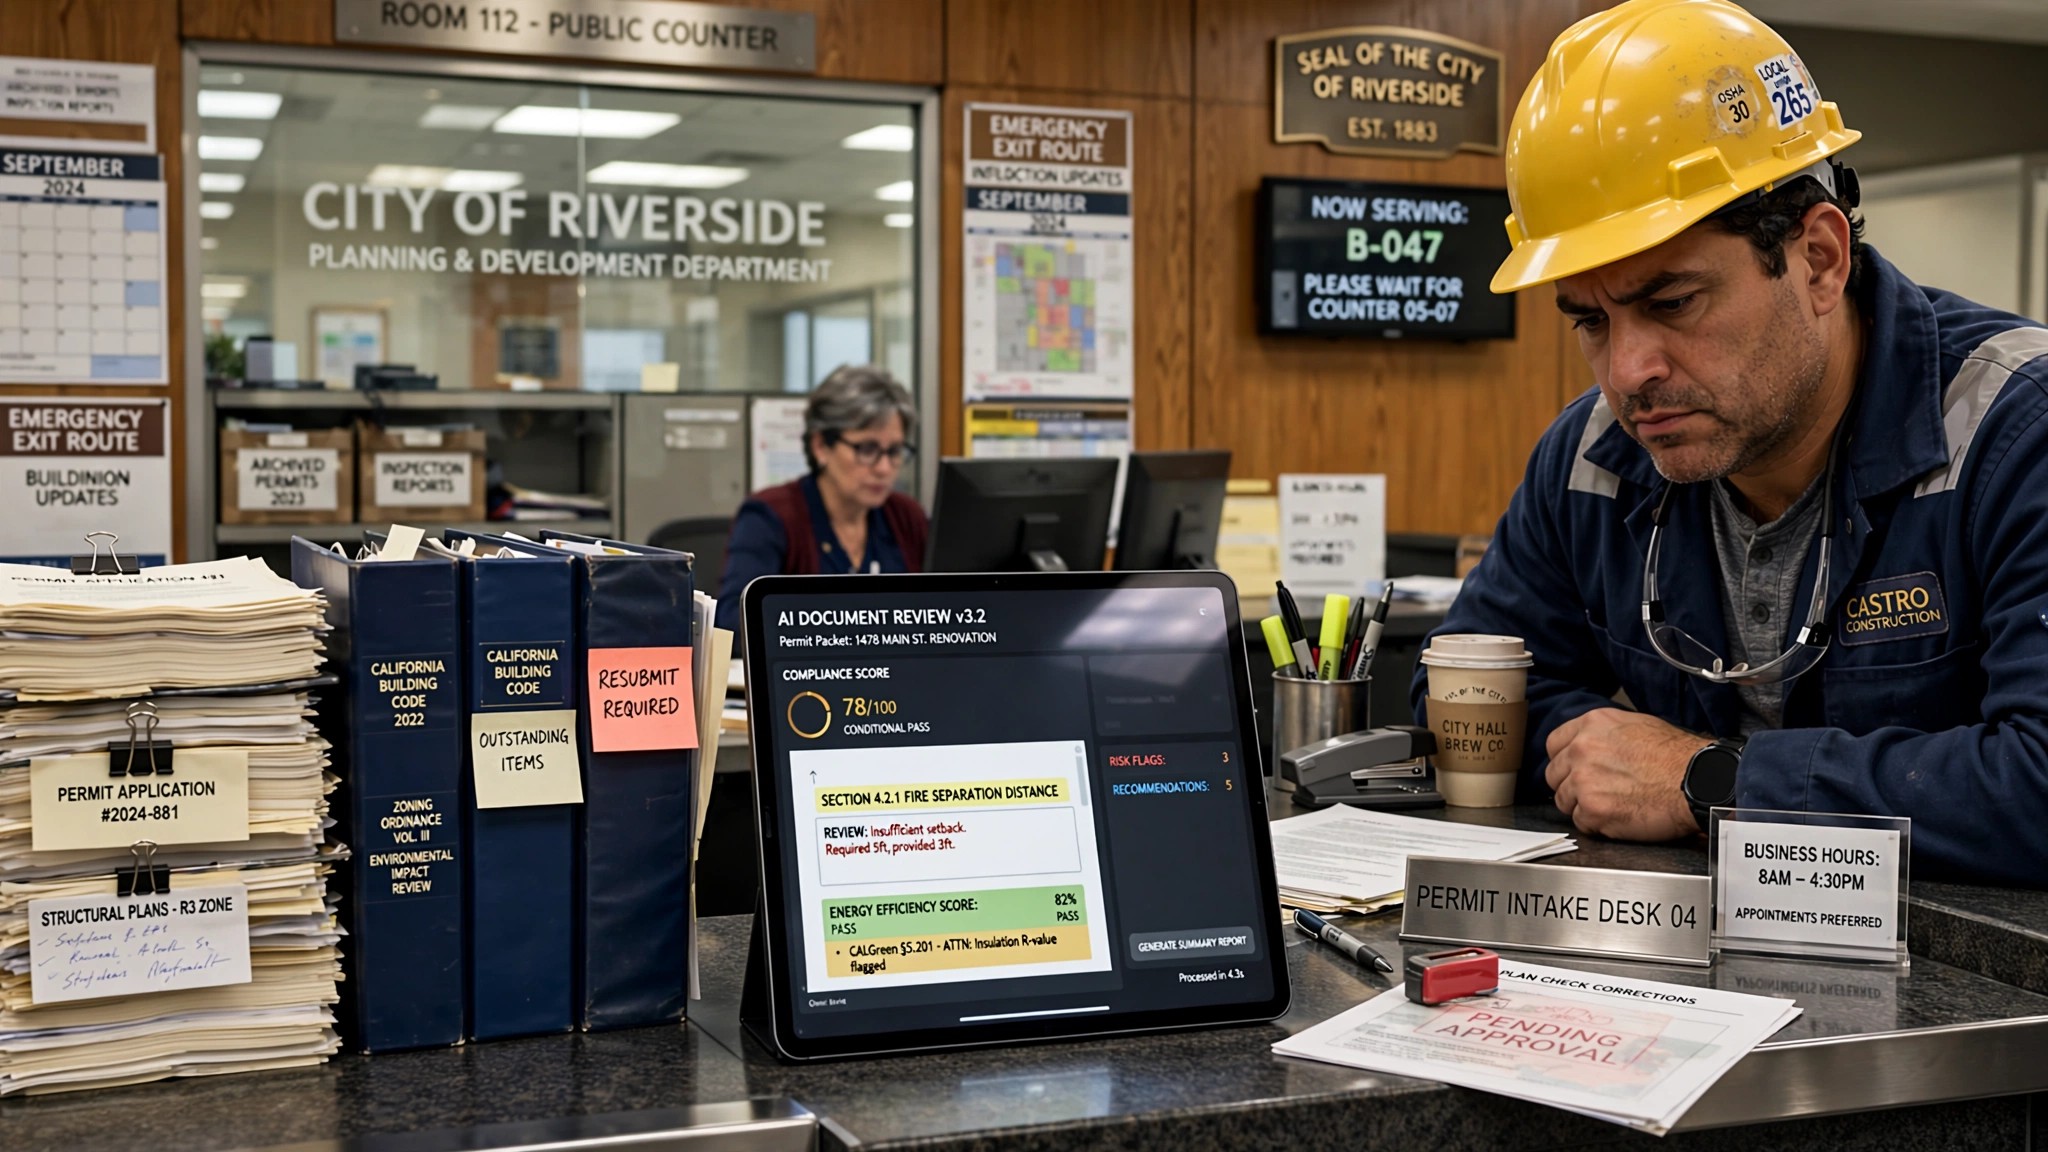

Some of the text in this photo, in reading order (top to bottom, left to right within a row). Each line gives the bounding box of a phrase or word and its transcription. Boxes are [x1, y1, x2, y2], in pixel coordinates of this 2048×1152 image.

[381, 0, 779, 52] ROOM 112 PUBLIC COUNTER
[1296, 41, 1486, 85] SEAL OF THE CITY
[1758, 59, 1789, 81] LOCAL
[1313, 74, 1464, 107] OF RIVERSIDE
[1717, 84, 1746, 104] OSHA
[1728, 100, 1750, 123] 30
[1771, 82, 1812, 126] 265
[990, 114, 1108, 140] EMERGENCY
[1347, 116, 1438, 143] EST. 1883
[992, 136, 1104, 163] EXIT ROUTE
[2, 153, 125, 177] SEPTEMBER
[43, 180, 85, 196] 2024
[978, 189, 1088, 213] SEPTEMBER
[1311, 195, 1469, 225] NOW SERVING:
[302, 182, 826, 247] CITY OF RIVERSIDE
[1346, 227, 1444, 264] B-047
[308, 242, 833, 283] PLANNING & DEVELOPMENT DEPARTMENT
[1303, 272, 1464, 299] PLEASE WAIT FOR
[1307, 297, 1460, 323] COUNTER 05-07
[8, 408, 143, 429] EMERGENCY
[12, 431, 140, 452] EXIT ROUTE
[250, 457, 326, 473] ARCHIVED
[381, 461, 465, 476] INSPECTION
[254, 474, 319, 489] PERMITS
[392, 477, 455, 494] REPORTS
[35, 489, 119, 507] UPDATES
[1846, 587, 1930, 619] CASTRO
[778, 608, 987, 627] AI DOCUMENT REVIEW v3.2
[1846, 608, 1942, 633] CONSTRUCTION
[779, 631, 998, 648] Permit Packet: 1478 MAIN ST. RENOVATION
[486, 648, 559, 664] CALIFORNIA
[370, 659, 446, 676] CALIFORNIA
[494, 664, 551, 680] BUILDING
[782, 666, 891, 681] COMPLIANCE SCORE
[379, 676, 438, 693] BUILDING
[505, 681, 541, 696] CODE
[598, 667, 680, 690] RESUBMIT
[391, 694, 427, 709] CODE
[603, 696, 680, 720] REQUIRED
[842, 696, 898, 717] 78/100
[393, 712, 425, 727] 2022
[843, 721, 931, 736] CONDITIONAL PASS
[1442, 719, 1508, 737] CITY HALL
[479, 727, 570, 749] OUTSTANDING
[1445, 737, 1506, 753] BREW CO.
[501, 753, 545, 772] ITEMS
[1108, 751, 1230, 767] RISK FLAGS: 3
[57, 780, 216, 802] PERMIT APPLICATION
[820, 784, 1060, 807] SECTION 4.2.1 FIRE SEPARATION DISTANCE
[1112, 779, 1233, 796] RECOMMENDATIONS: 5
[100, 804, 179, 823] #2024-881
[392, 798, 434, 814] ZONING
[380, 813, 443, 830] ORDINANCE
[823, 821, 967, 839] REVIEW: Insufficient setback.
[393, 829, 430, 844] VOL. III
[369, 848, 455, 867] ENVIRONMENTAL
[825, 837, 957, 858] Required 5ft, provided 3ft.
[1743, 842, 1881, 867] BUSINESS HOURS:
[391, 865, 430, 880] IMPACT
[1758, 868, 1865, 891] 8AM 4:30PM
[392, 880, 432, 895] REVIEW
[41, 896, 233, 927] STRUCTURAL PLANS R3 ZONE
[829, 892, 1078, 919] ENERGY EFFICIENCY SCORE: 82%
[1416, 884, 1697, 930] PERMIT INTAKE DESK 04
[831, 909, 1080, 936] PASS PASS
[1734, 906, 1883, 929] APPOINTMENTS PREFERRED
[849, 944, 899, 958] CALGreen
[942, 938, 972, 952] ATTN:
[974, 934, 1021, 950] Insulation
[1021, 932, 1058, 947] R-value
[1137, 935, 1248, 953] GENERATE SUMMARY REPORT
[850, 959, 887, 976] flagged
[1178, 967, 1246, 984] Processed in 4.3s
[1499, 969, 1698, 1006] PLAN CHECK CORRECTIONS
[1466, 1011, 1623, 1049] PENDING
[1435, 1023, 1620, 1066] APPROVAL
